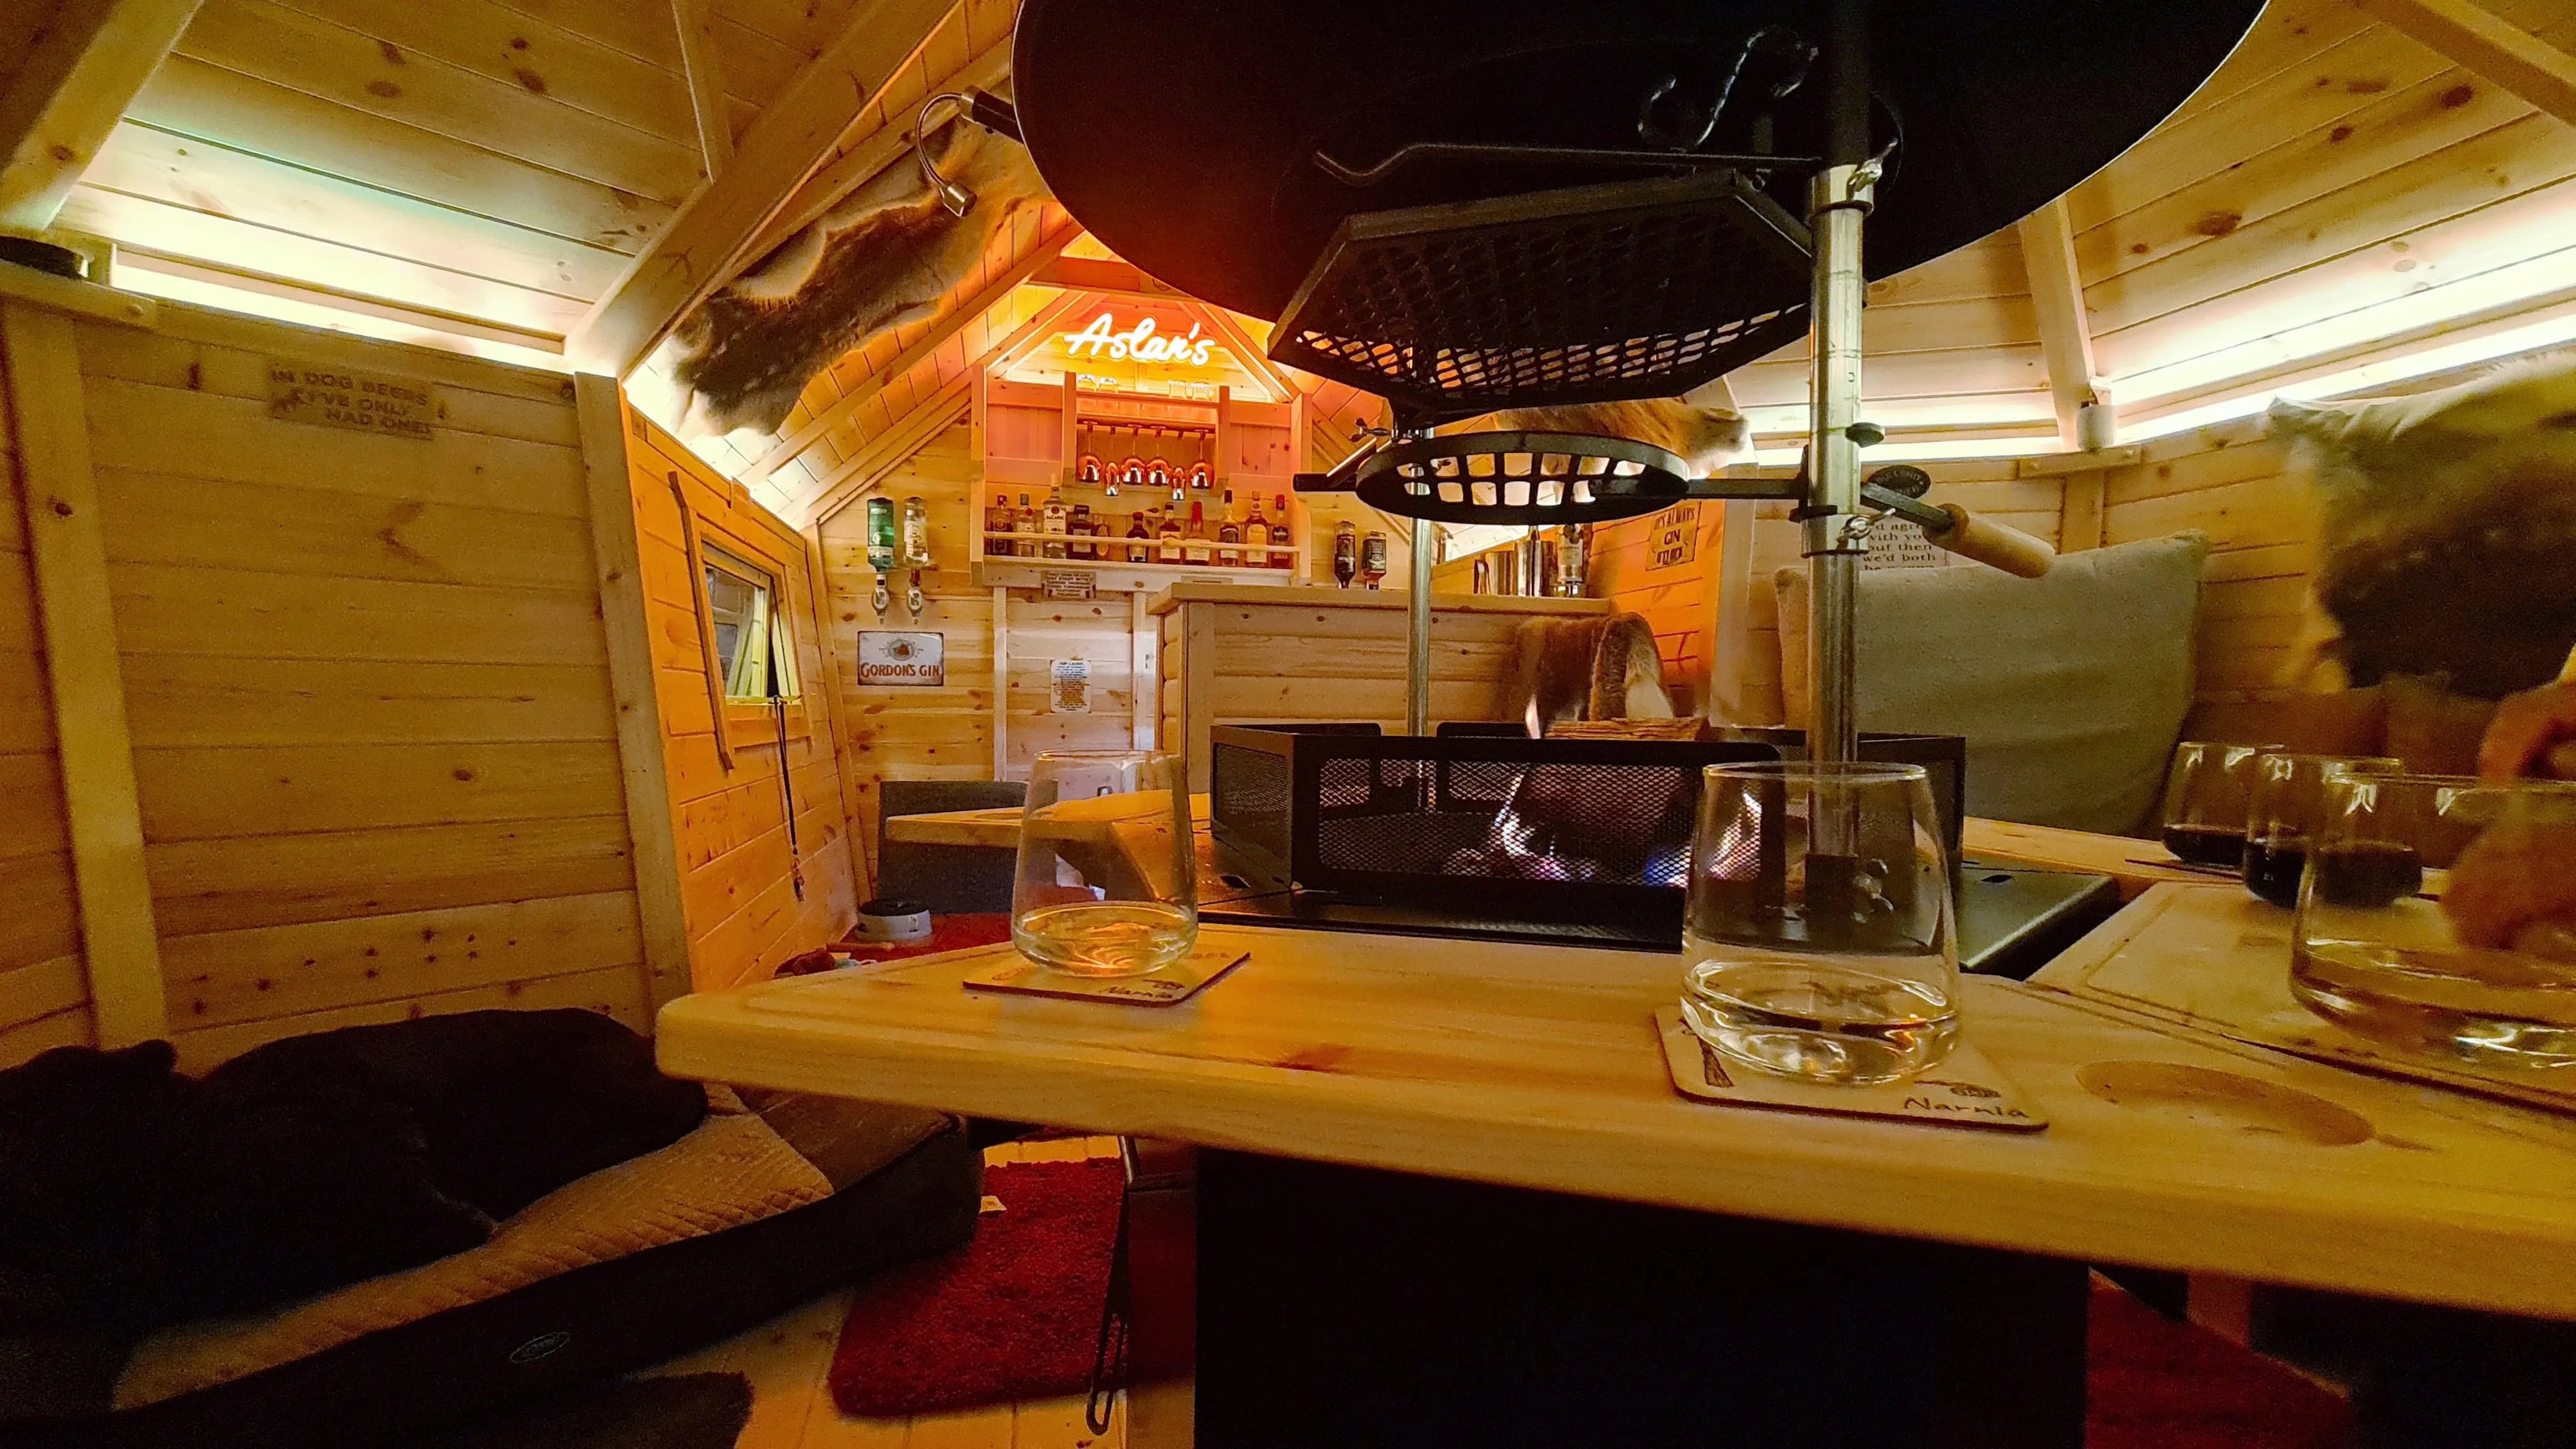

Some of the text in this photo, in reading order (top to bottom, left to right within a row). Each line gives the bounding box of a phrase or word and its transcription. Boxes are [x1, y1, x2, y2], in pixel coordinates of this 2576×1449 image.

[1064, 312, 1215, 366] Aslan's
[304, 371, 353, 390] DOG
[1664, 528, 1681, 545] GIN
[1862, 553, 1936, 562] we'd both
[861, 663, 940, 678] GORDON'S GIN
[1904, 1096, 2032, 1119] Narnia
